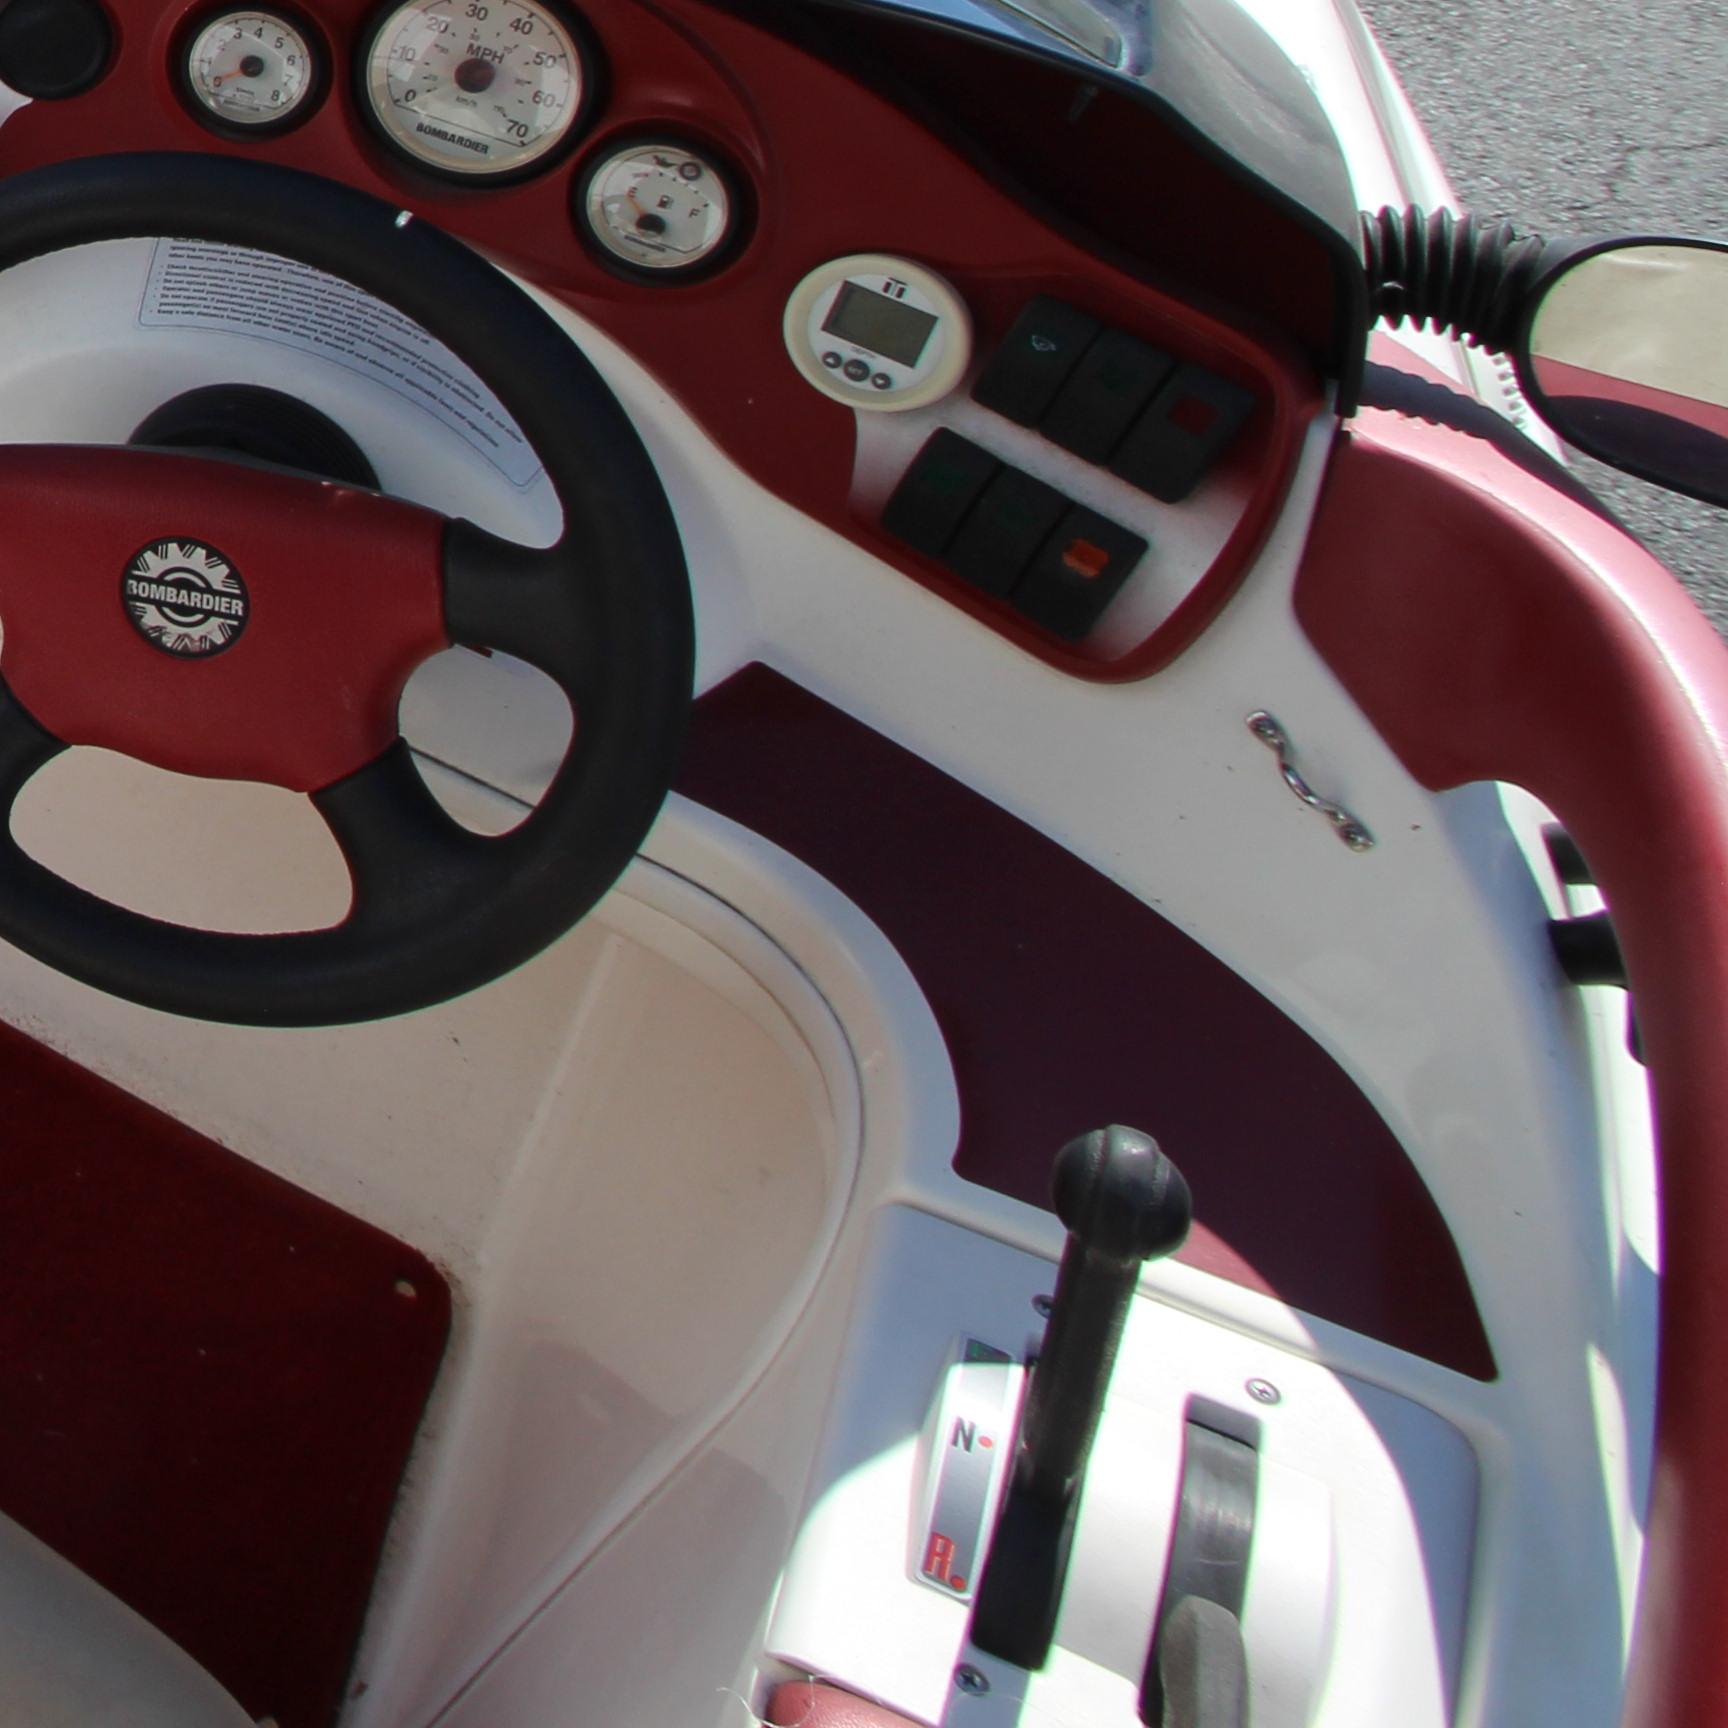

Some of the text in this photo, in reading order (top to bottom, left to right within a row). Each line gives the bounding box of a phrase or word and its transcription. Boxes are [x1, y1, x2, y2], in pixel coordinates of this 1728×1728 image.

[465, 3, 489, 21] 30
[233, 27, 243, 40] 3
[253, 27, 263, 39] 4
[425, 16, 449, 34] 20
[509, 17, 534, 36] 40
[274, 36, 284, 49] 5
[287, 54, 296, 66] 6
[398, 45, 416, 62] 10
[465, 43, 506, 65] MPH
[532, 51, 557, 69] 50
[270, 89, 280, 102] 8
[404, 88, 417, 103] 0
[531, 89, 556, 108] 60
[505, 118, 529, 139] 70
[415, 122, 490, 155] BOMBARDIER
[688, 207, 700, 219] F
[126, 578, 244, 617] BOMBARDIER
[951, 1417, 976, 1453] N
[920, 1531, 956, 1581] R
